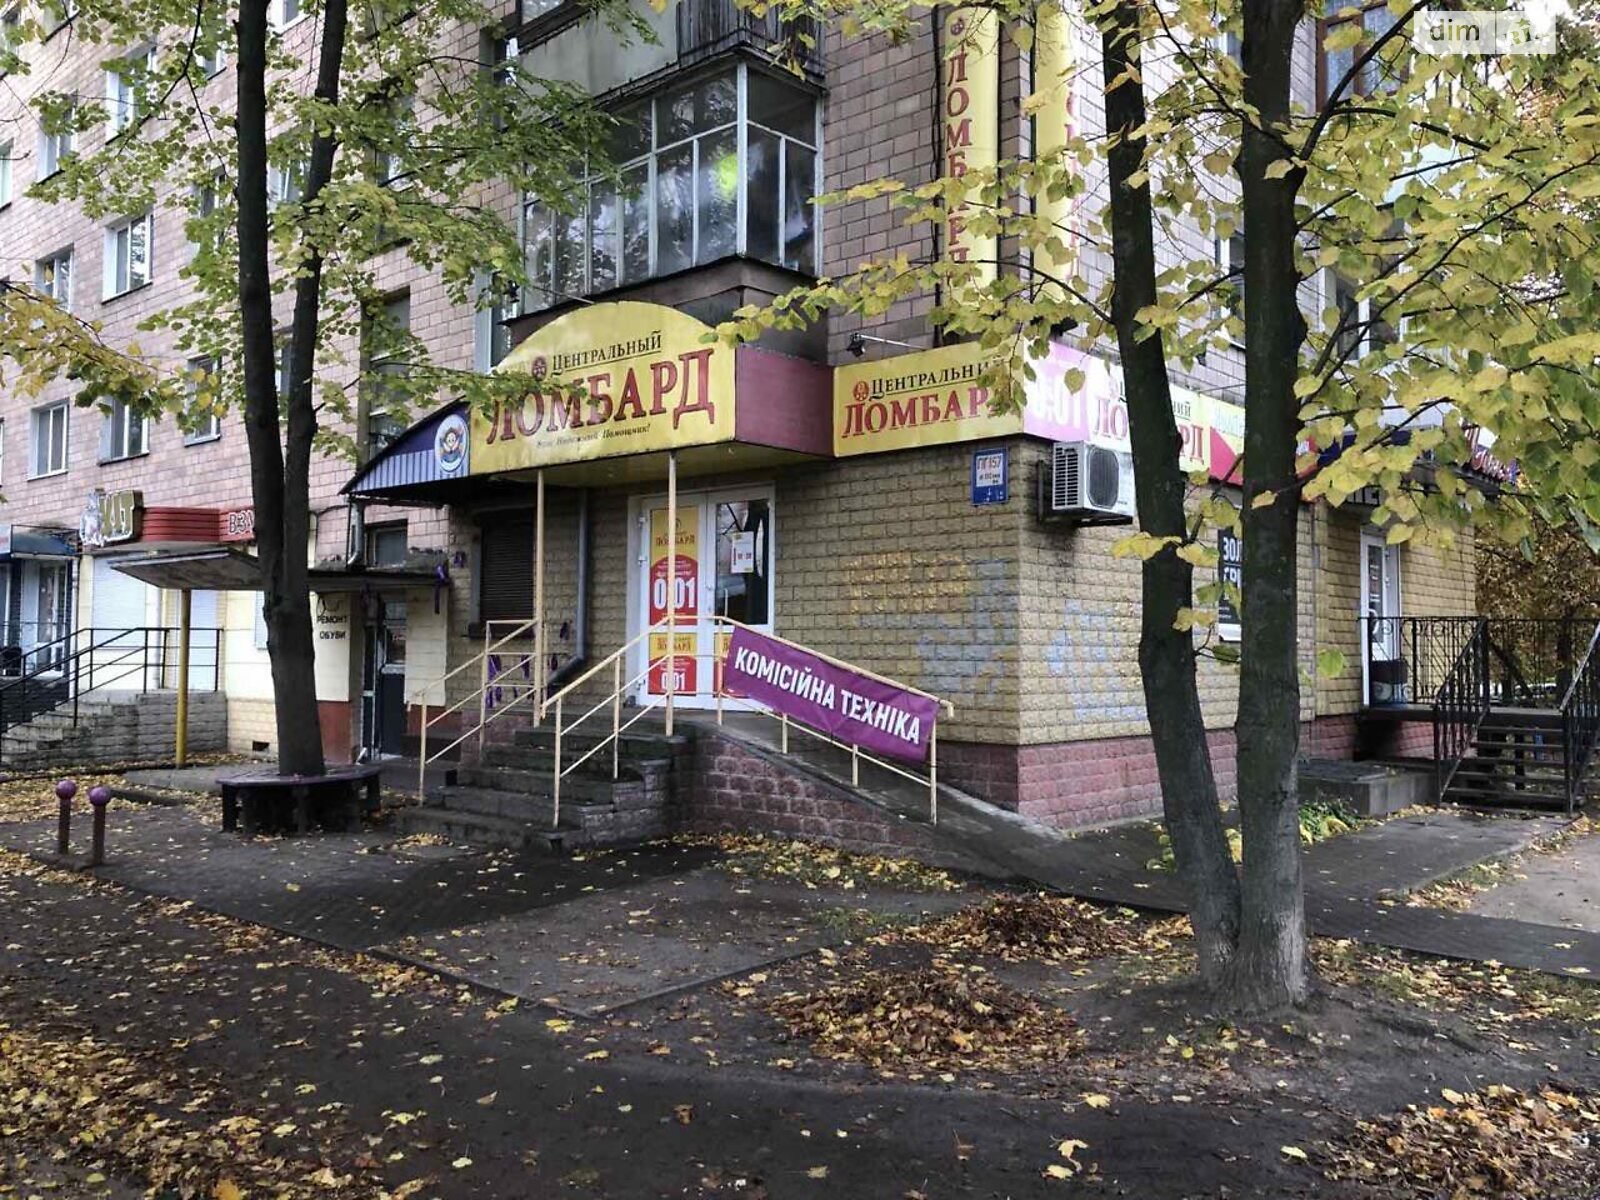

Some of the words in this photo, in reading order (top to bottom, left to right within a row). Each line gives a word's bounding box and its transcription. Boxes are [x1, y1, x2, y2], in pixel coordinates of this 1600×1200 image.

[551, 330, 662, 376] ЦЕНТРАЛЬНЫЙ
[486, 348, 715, 445] ЛОМБАРД
[870, 361, 990, 400] ЦЕНТРАЛЬНИ
[841, 386, 990, 438] ЛОМБАР
[735, 646, 835, 710] КОМІСІЙНА
[841, 690, 920, 745] ТЕХНІКА
